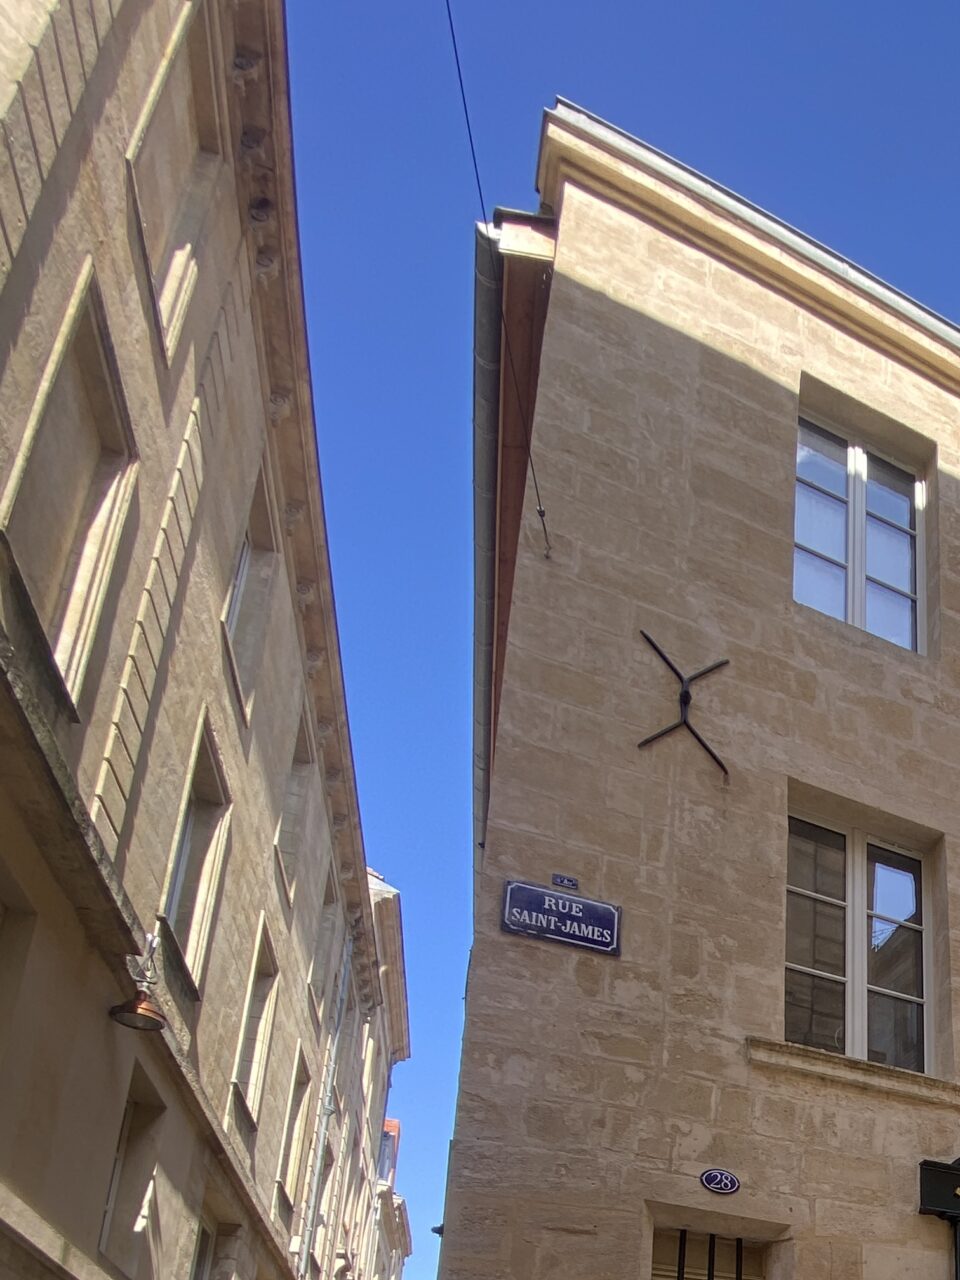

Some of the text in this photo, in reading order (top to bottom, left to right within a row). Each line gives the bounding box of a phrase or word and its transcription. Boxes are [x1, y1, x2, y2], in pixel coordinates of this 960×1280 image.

[543, 896, 583, 917] RUE
[511, 907, 611, 943] SAINT-JAMES
[710, 1172, 731, 1190] 28
